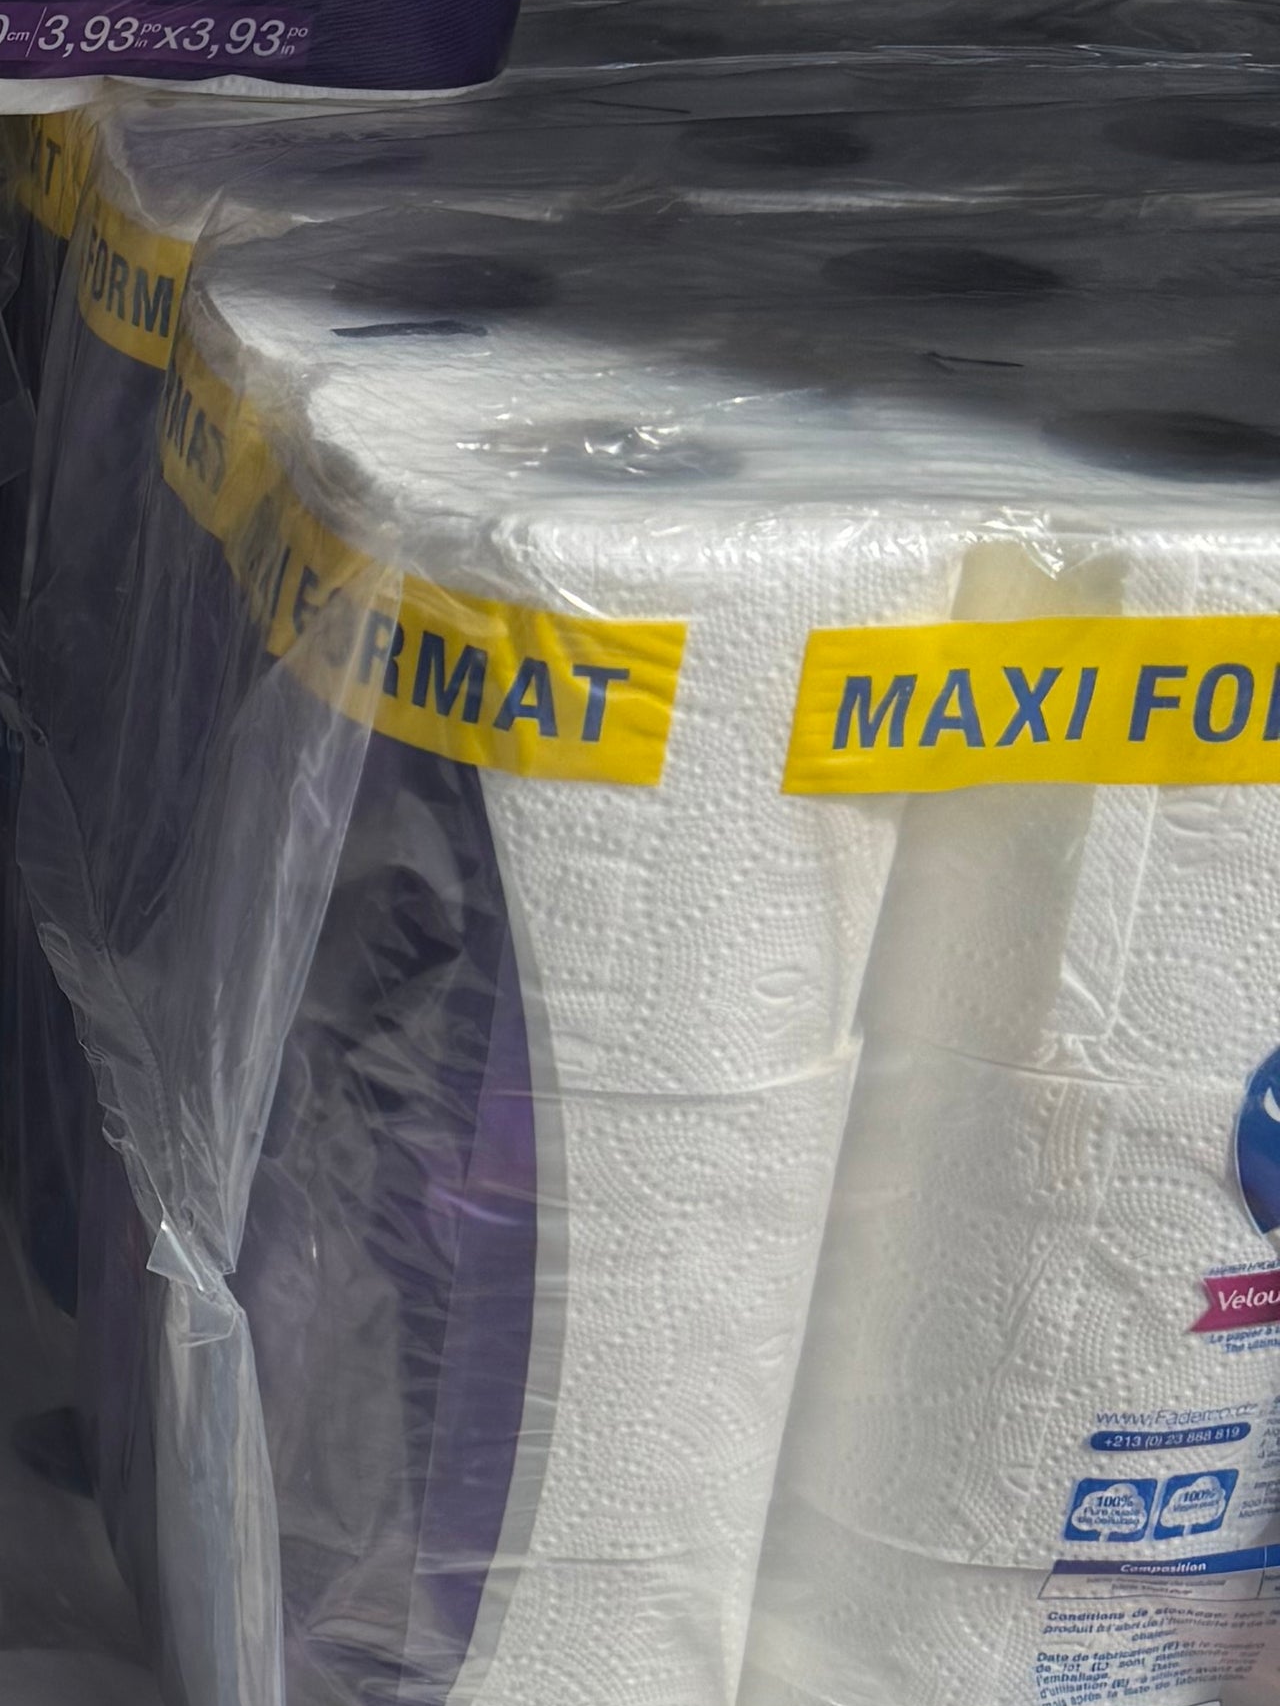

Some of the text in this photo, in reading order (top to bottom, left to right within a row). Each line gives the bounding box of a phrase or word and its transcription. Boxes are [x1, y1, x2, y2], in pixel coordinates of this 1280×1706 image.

[82, 225, 176, 339] FORM
[291, 563, 631, 744] FRMAT
[831, 662, 1280, 751] MAXI FO
[1104, 1434, 1141, 1448] +213
[1144, 1434, 1164, 1449] (0)
[1165, 1433, 1184, 1447] 23
[1214, 1425, 1240, 1441] 819
[1095, 1495, 1134, 1508] 100%
[1119, 1561, 1208, 1575] Composition
[1046, 1610, 1126, 1622] Conditions
